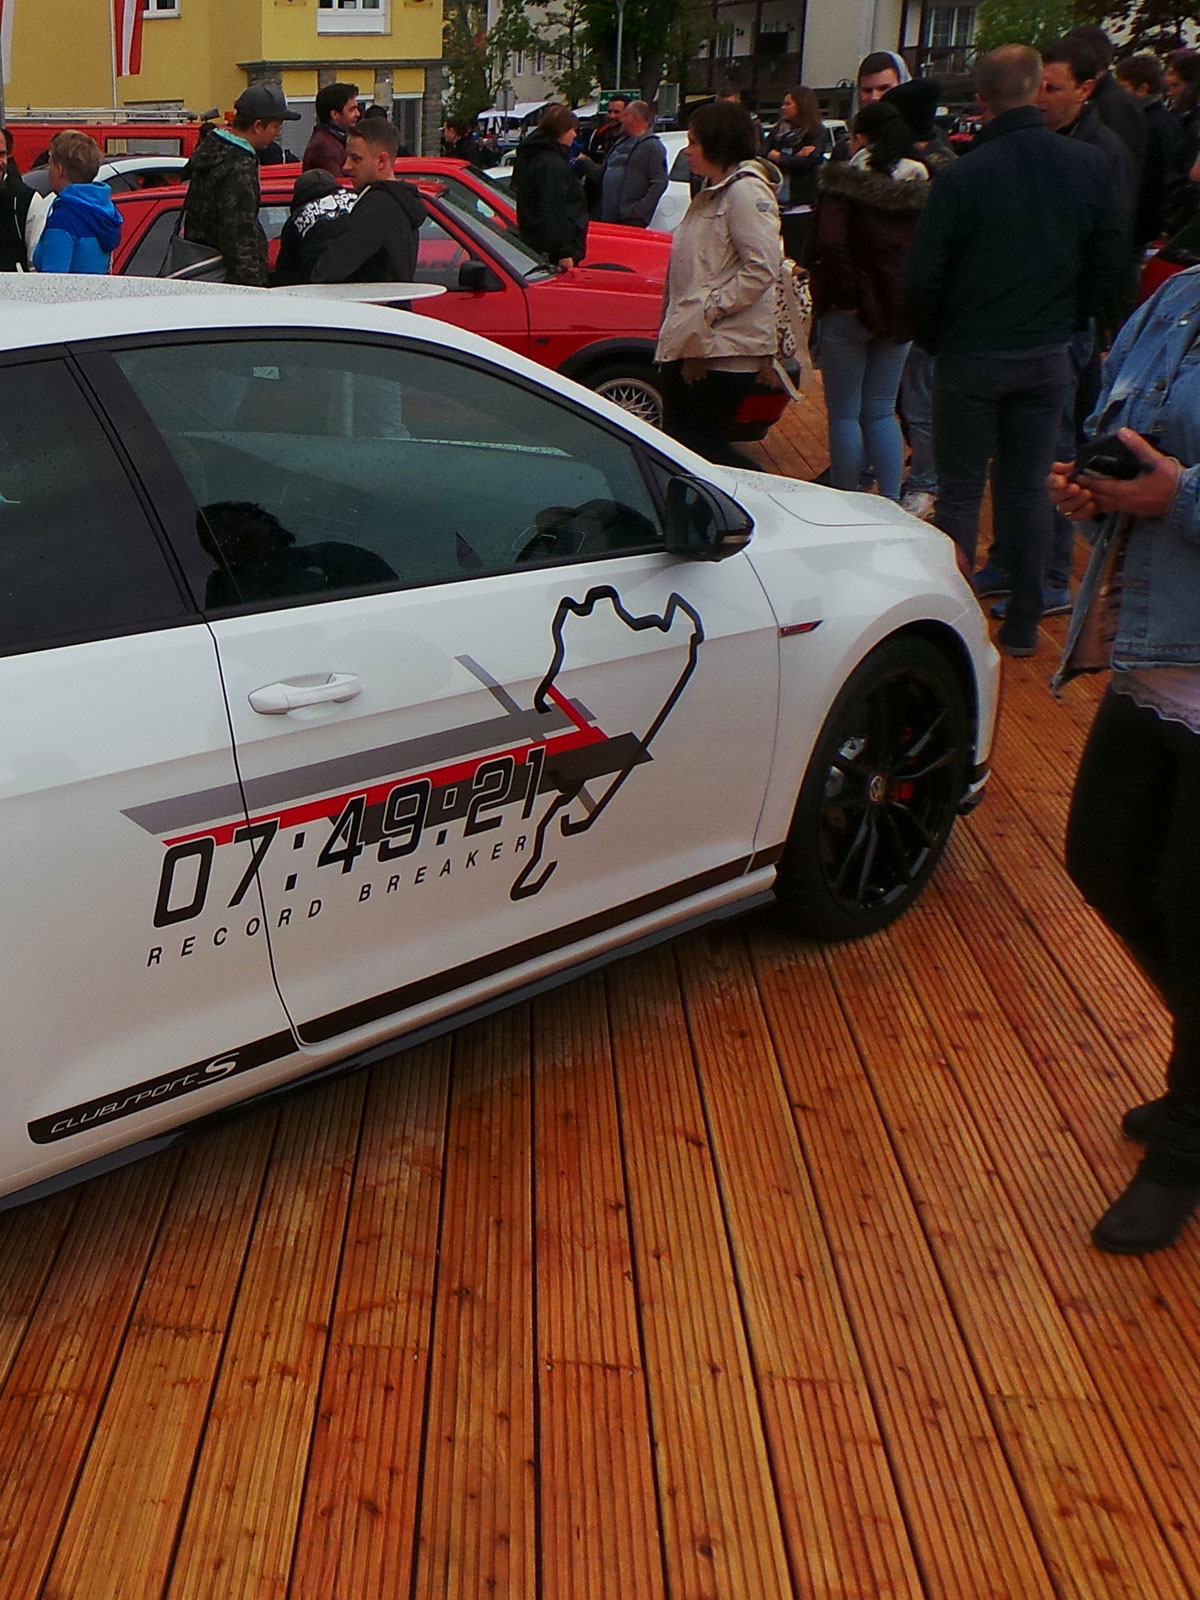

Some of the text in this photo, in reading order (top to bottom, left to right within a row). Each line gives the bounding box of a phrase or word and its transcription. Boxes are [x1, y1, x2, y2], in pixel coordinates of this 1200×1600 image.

[147, 835, 527, 967] RECORD BREAKER
[153, 746, 547, 929] 07:49:21
